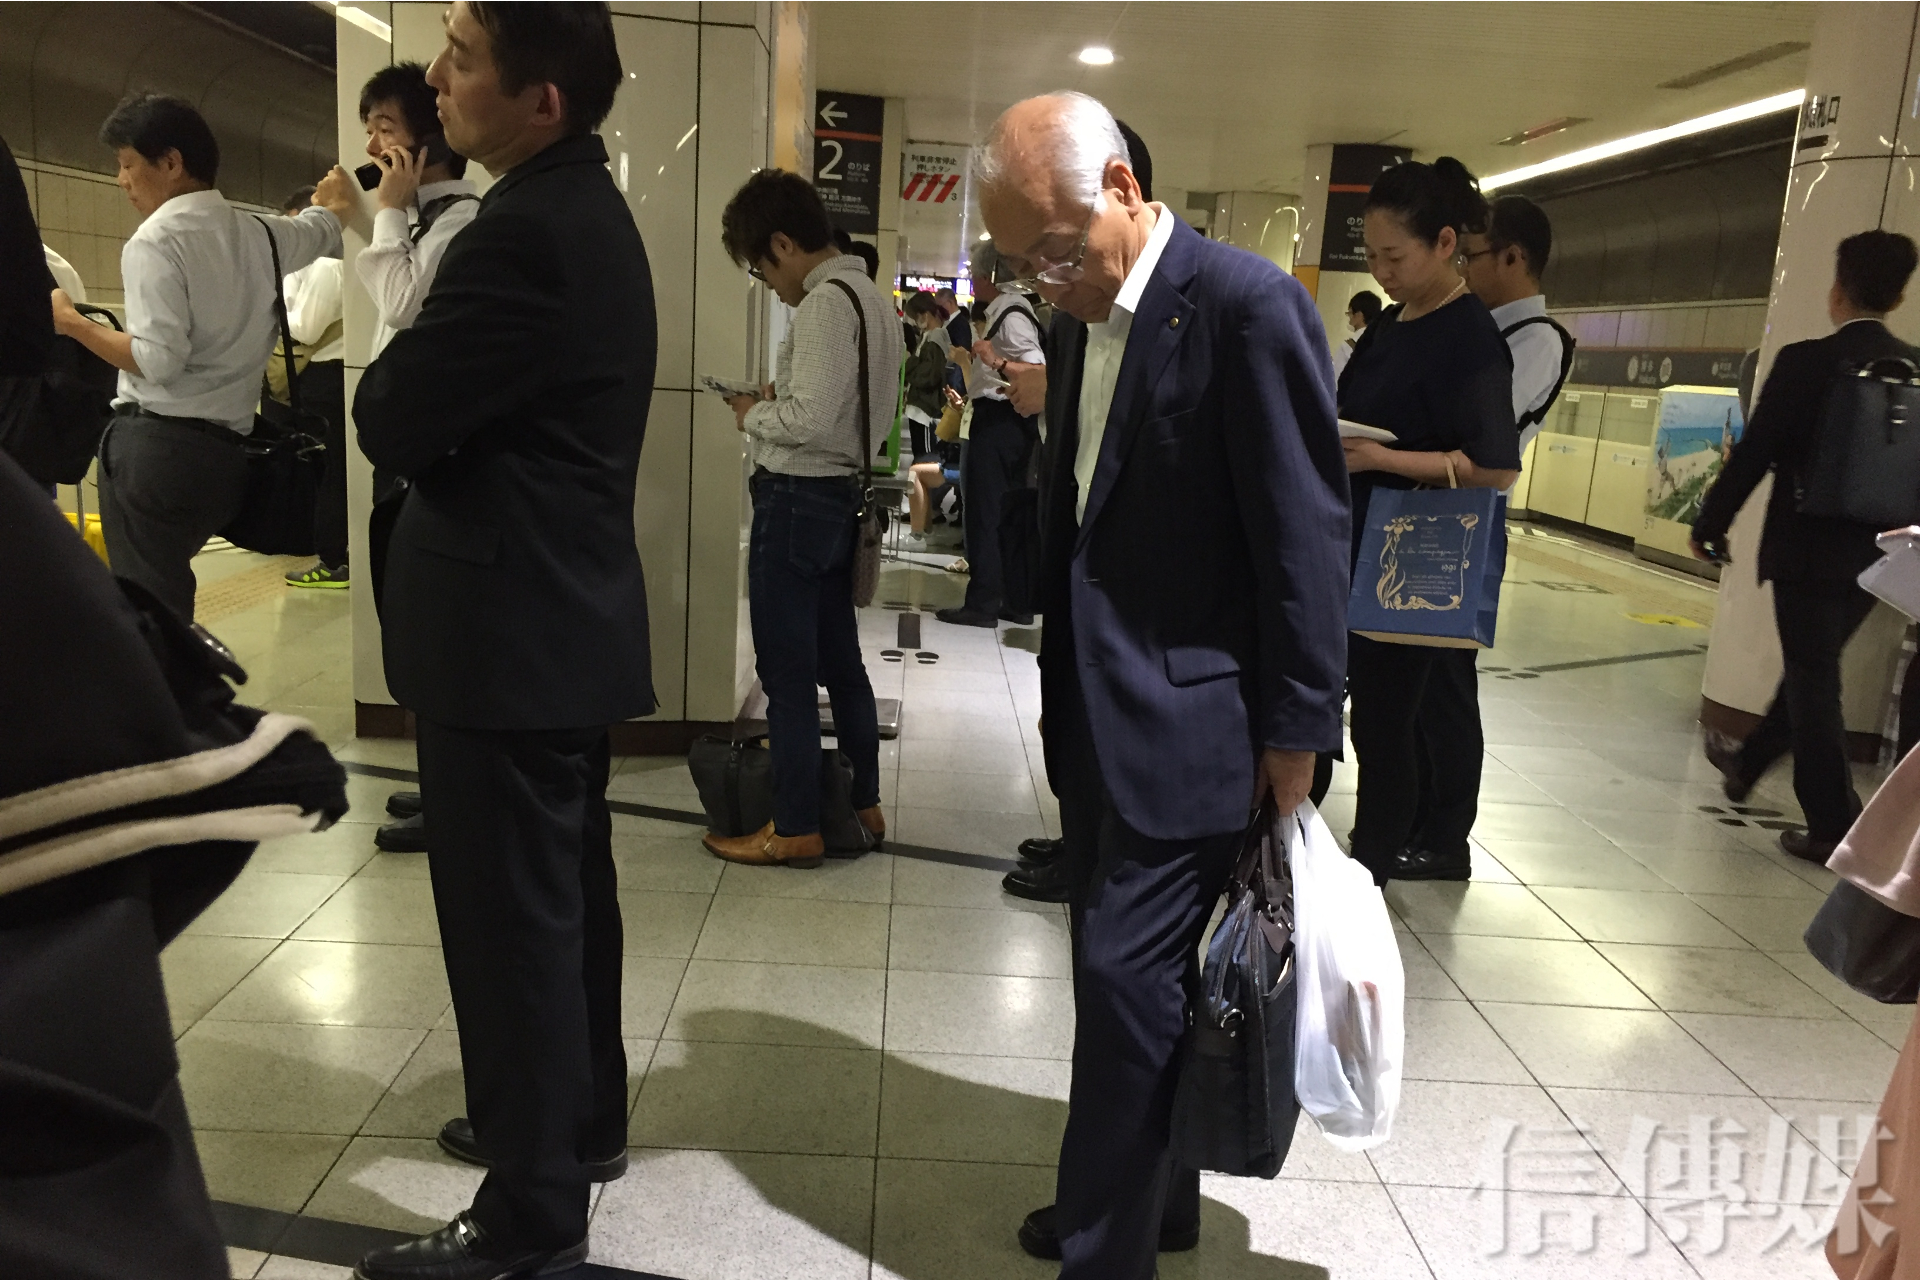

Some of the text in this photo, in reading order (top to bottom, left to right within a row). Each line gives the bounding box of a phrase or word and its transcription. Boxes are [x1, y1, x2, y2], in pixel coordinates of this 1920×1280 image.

[819, 140, 843, 180] 2
[848, 162, 870, 171] のりば
[951, 192, 958, 201] 3
[1347, 217, 1363, 225] のり
